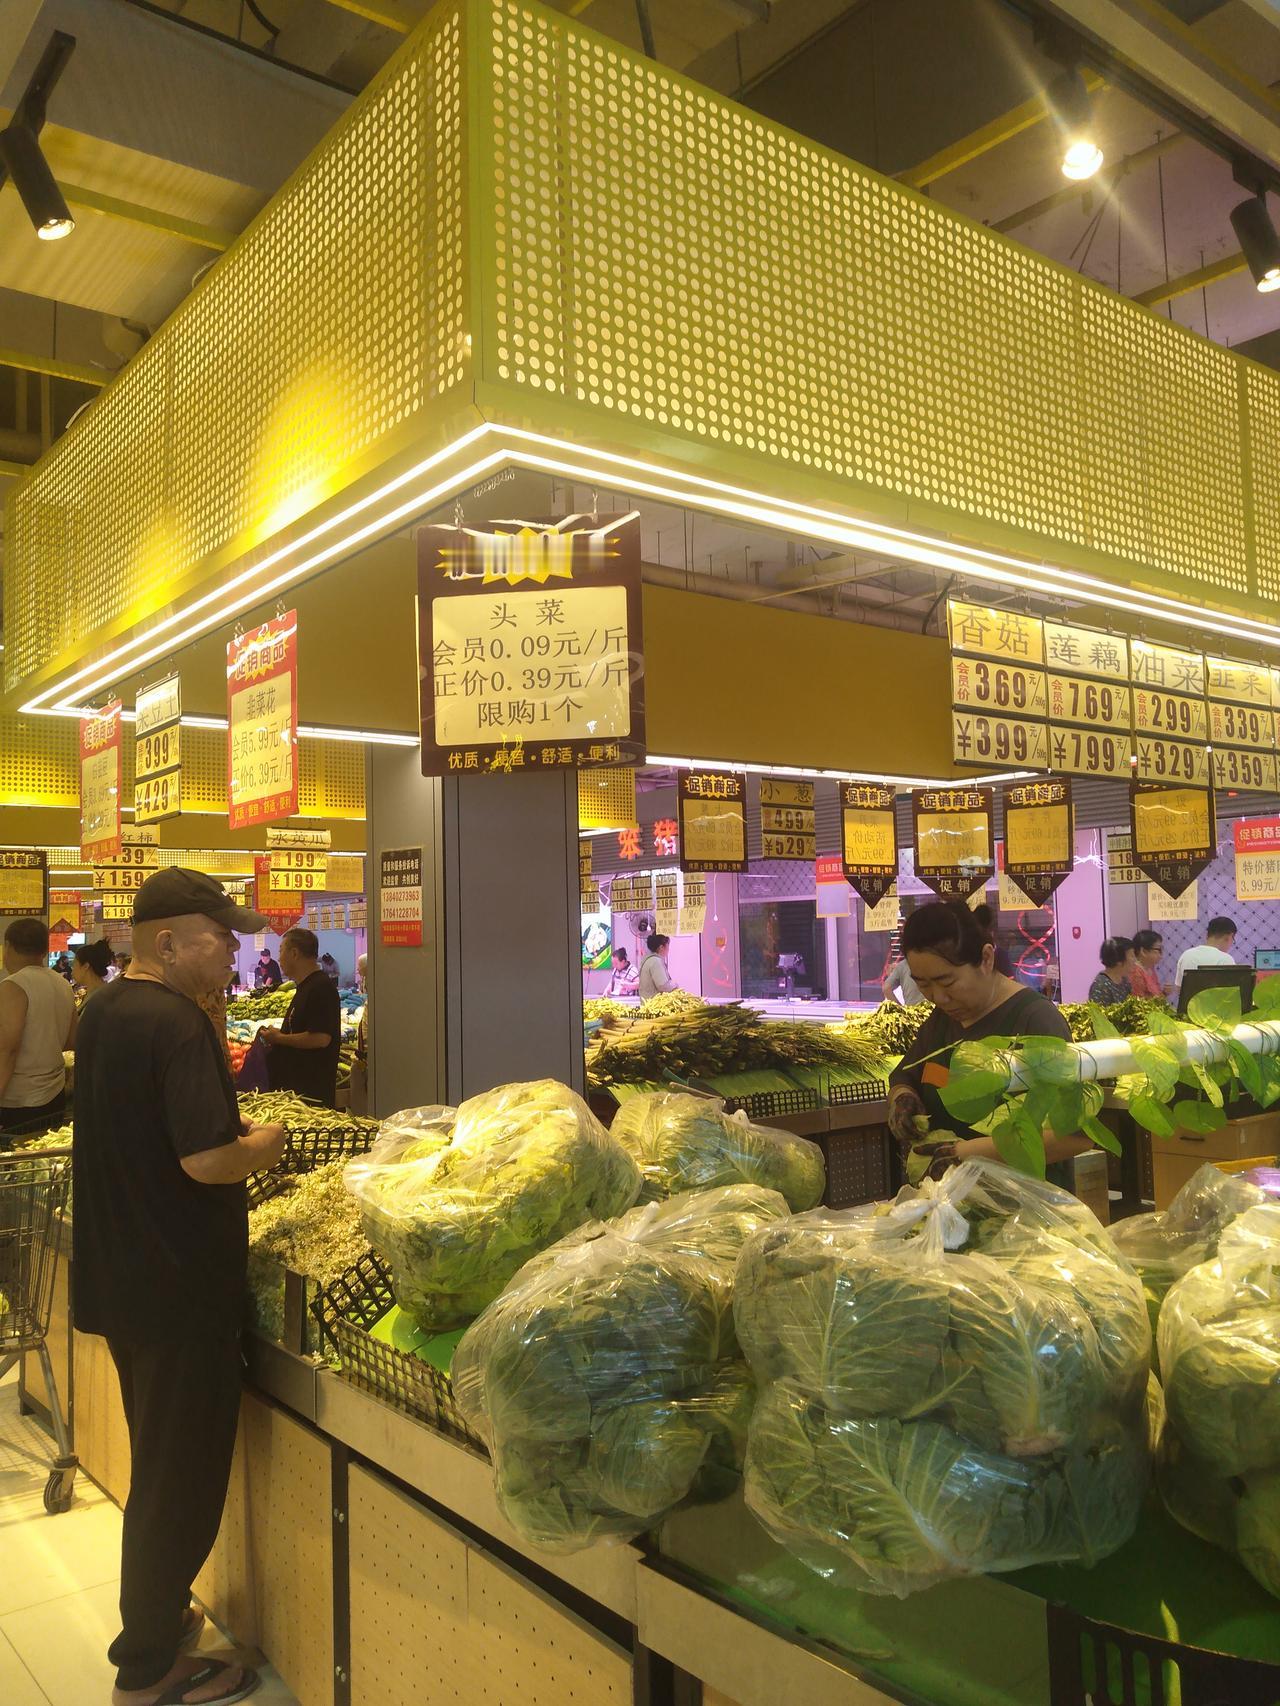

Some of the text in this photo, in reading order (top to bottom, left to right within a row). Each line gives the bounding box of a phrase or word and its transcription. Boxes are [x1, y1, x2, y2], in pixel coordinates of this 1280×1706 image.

[433, 626, 628, 667] 会员0.09元/斤
[954, 607, 1029, 655] 香菇
[1050, 633, 1121, 672] 莲藕
[434, 659, 629, 698] 正价0.39元/斤
[957, 662, 970, 701] 会员价
[1132, 649, 1204, 692] 油菜
[478, 696, 583, 728] 限购1个
[1051, 679, 1063, 716] 会员价
[924, 793, 980, 808] 促销商品
[0, 854, 38, 865] 销商品
[1160, 866, 1190, 881] 促销
[1243, 860, 1280, 876] 特价猪
[939, 880, 970, 892] 促销
[1026, 877, 1051, 891] 促销
